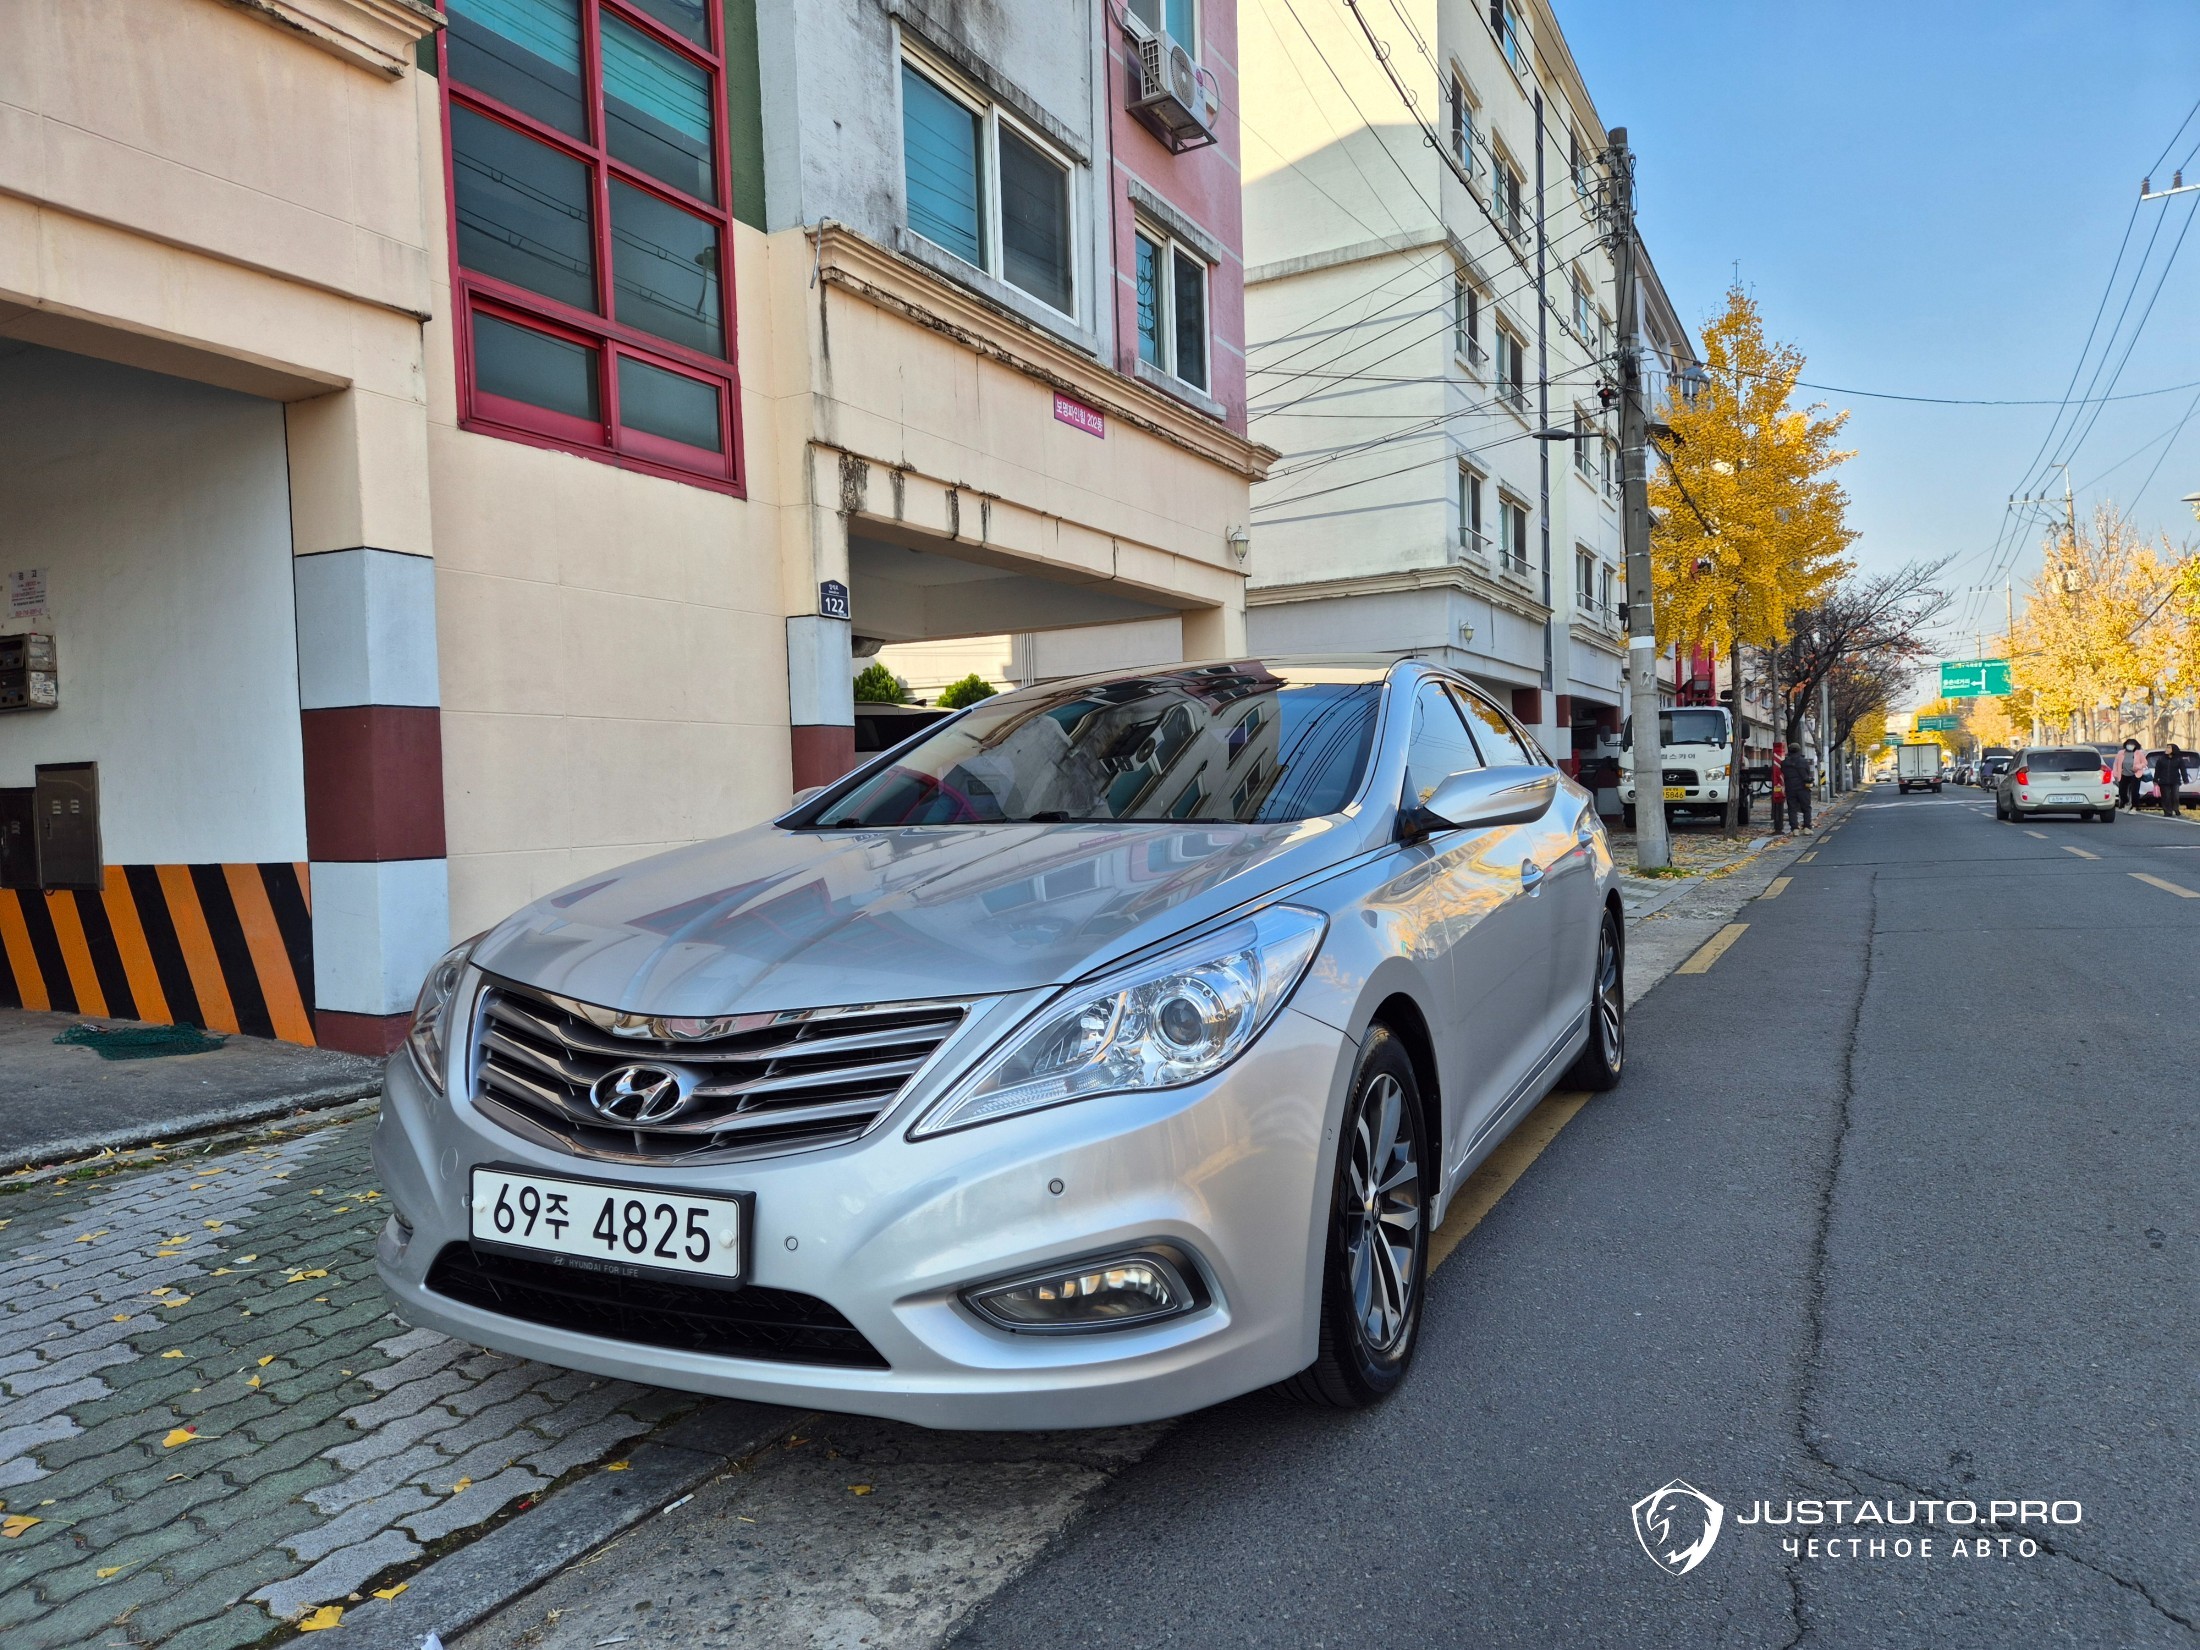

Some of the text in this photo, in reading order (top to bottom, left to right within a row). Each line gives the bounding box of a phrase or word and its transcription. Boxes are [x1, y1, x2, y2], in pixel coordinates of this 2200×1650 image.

[1087, 413, 1103, 433] 202동
[825, 597, 845, 614] 122
[1665, 791, 1684, 799] 5846
[493, 1183, 711, 1263] 69주 4825
[568, 1259, 639, 1278] HYUNDAI FOR LIFE
